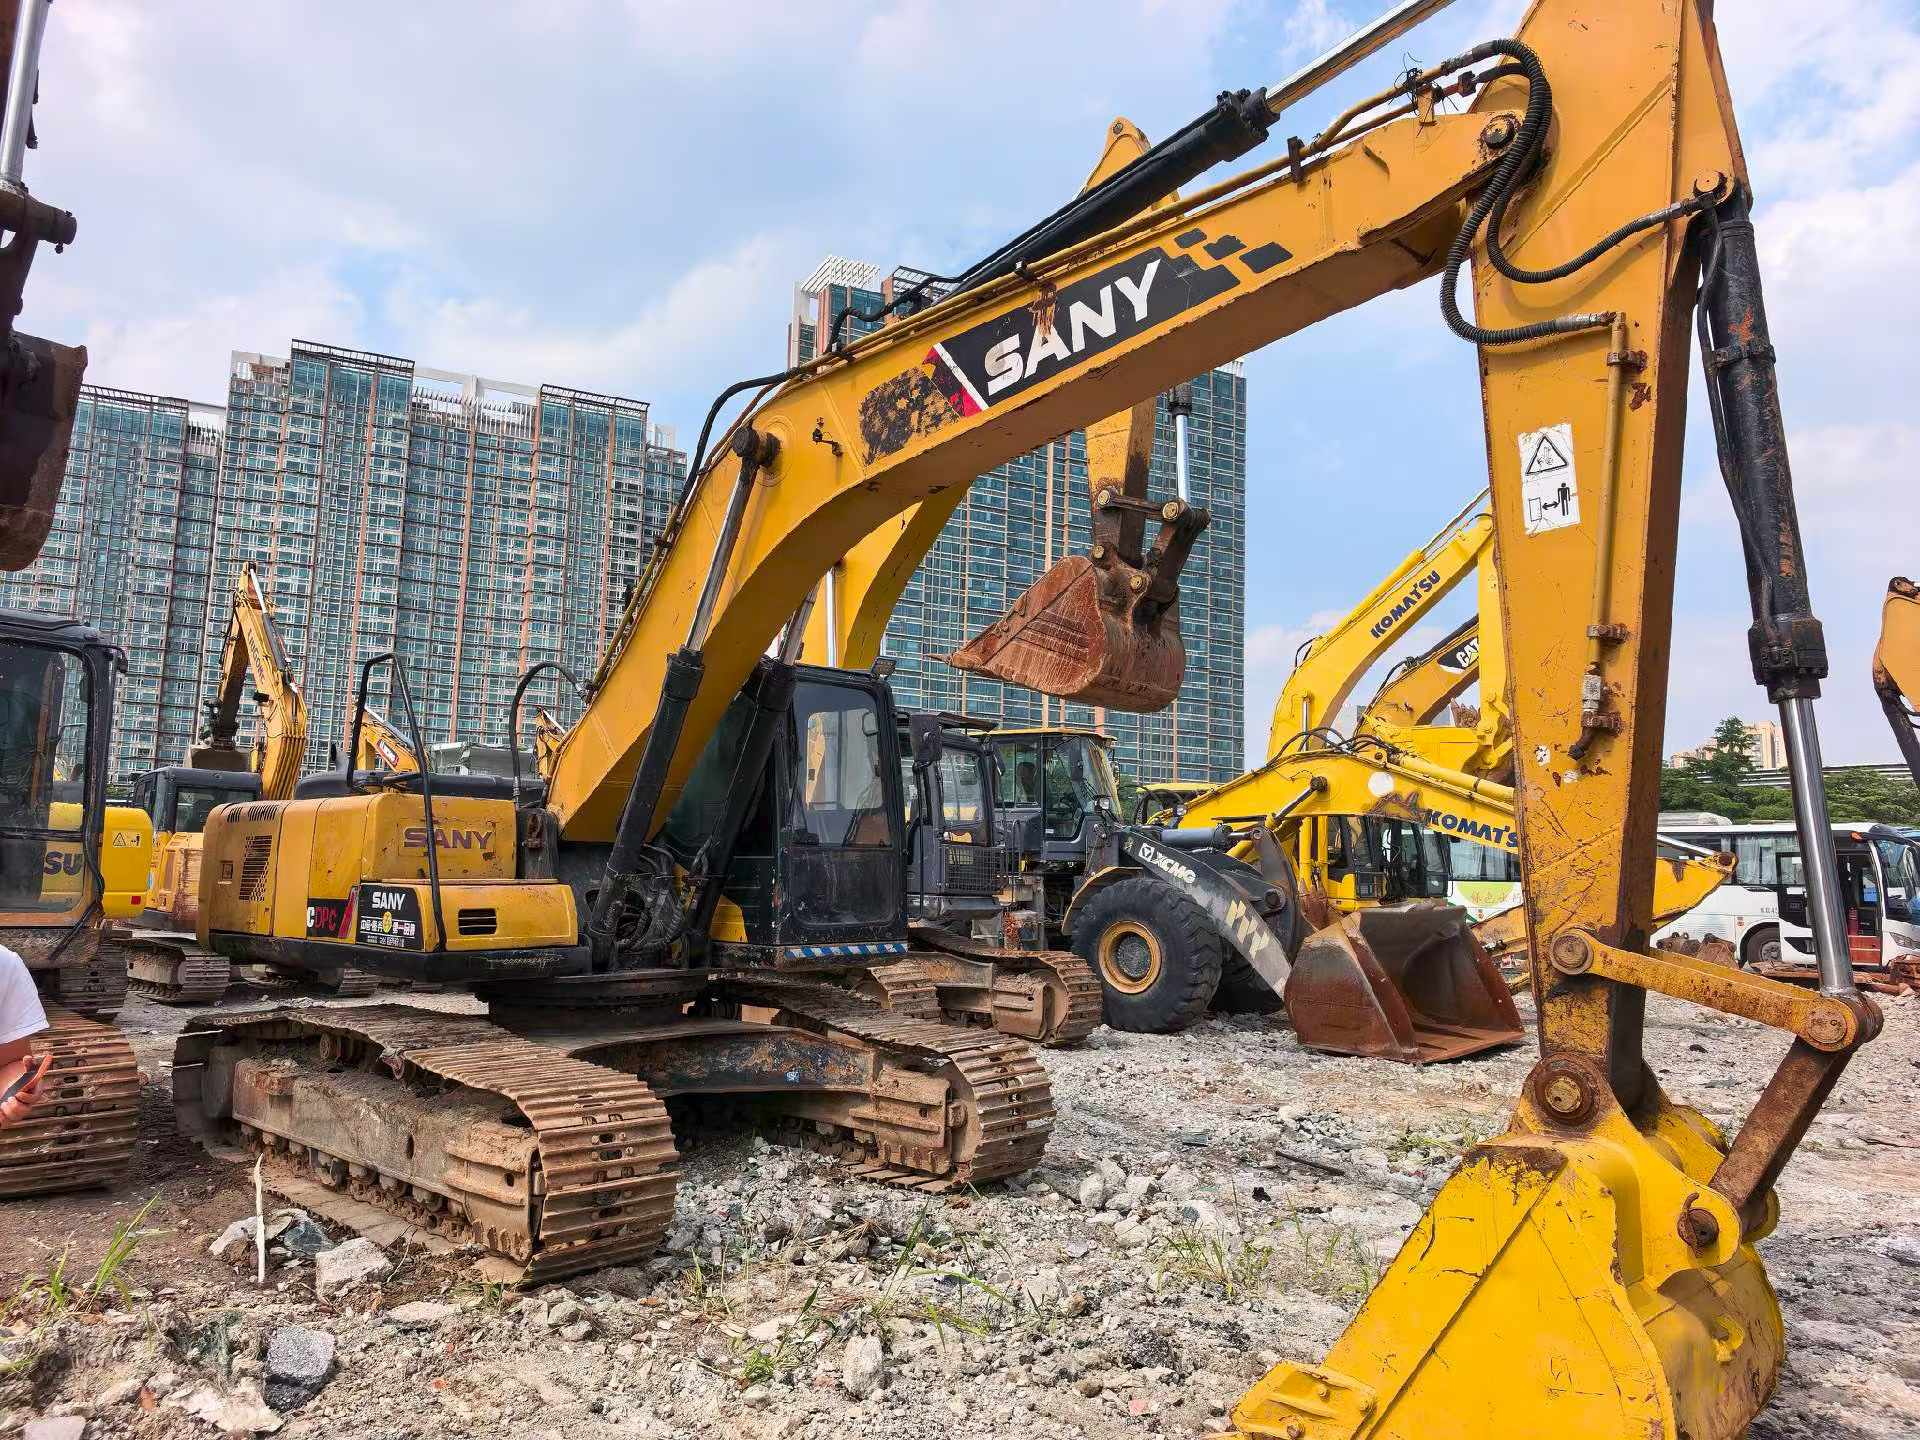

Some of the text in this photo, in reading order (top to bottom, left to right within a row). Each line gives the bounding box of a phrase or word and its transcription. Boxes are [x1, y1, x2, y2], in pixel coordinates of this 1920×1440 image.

[984, 258, 1162, 396] SANY
[1370, 570, 1441, 639] KOMATSU
[403, 827, 493, 849] SANY
[1150, 851, 1196, 884] XCMG
[371, 891, 406, 911] SANY
